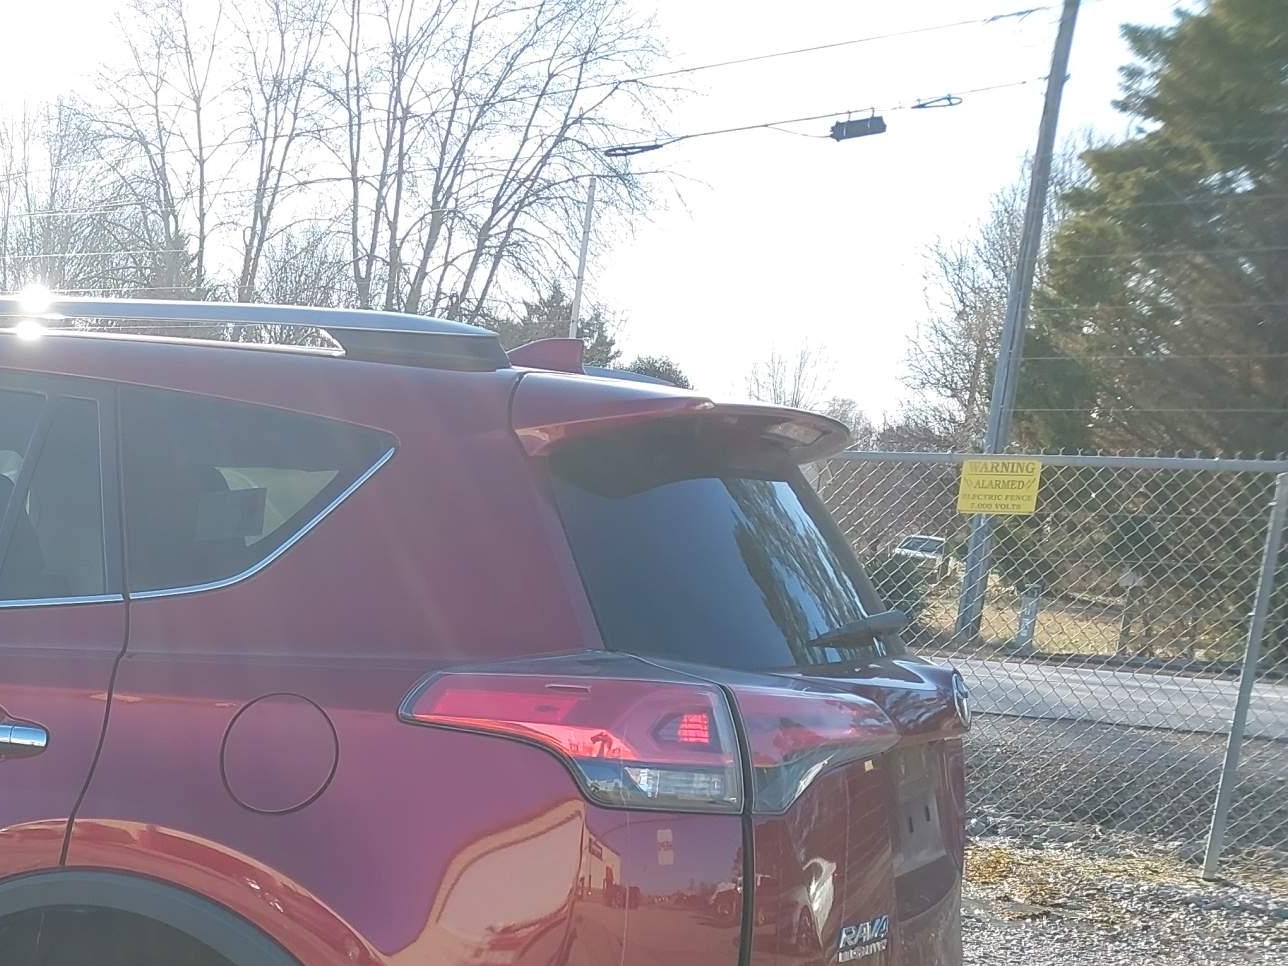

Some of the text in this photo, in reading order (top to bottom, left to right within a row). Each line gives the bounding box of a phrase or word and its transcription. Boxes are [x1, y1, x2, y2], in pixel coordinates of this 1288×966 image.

[969, 462, 1036, 474] WARNING
[974, 480, 1025, 490] ALARMED
[962, 493, 1033, 502] ELECTRIC FENCE
[839, 915, 889, 949] RAV4
